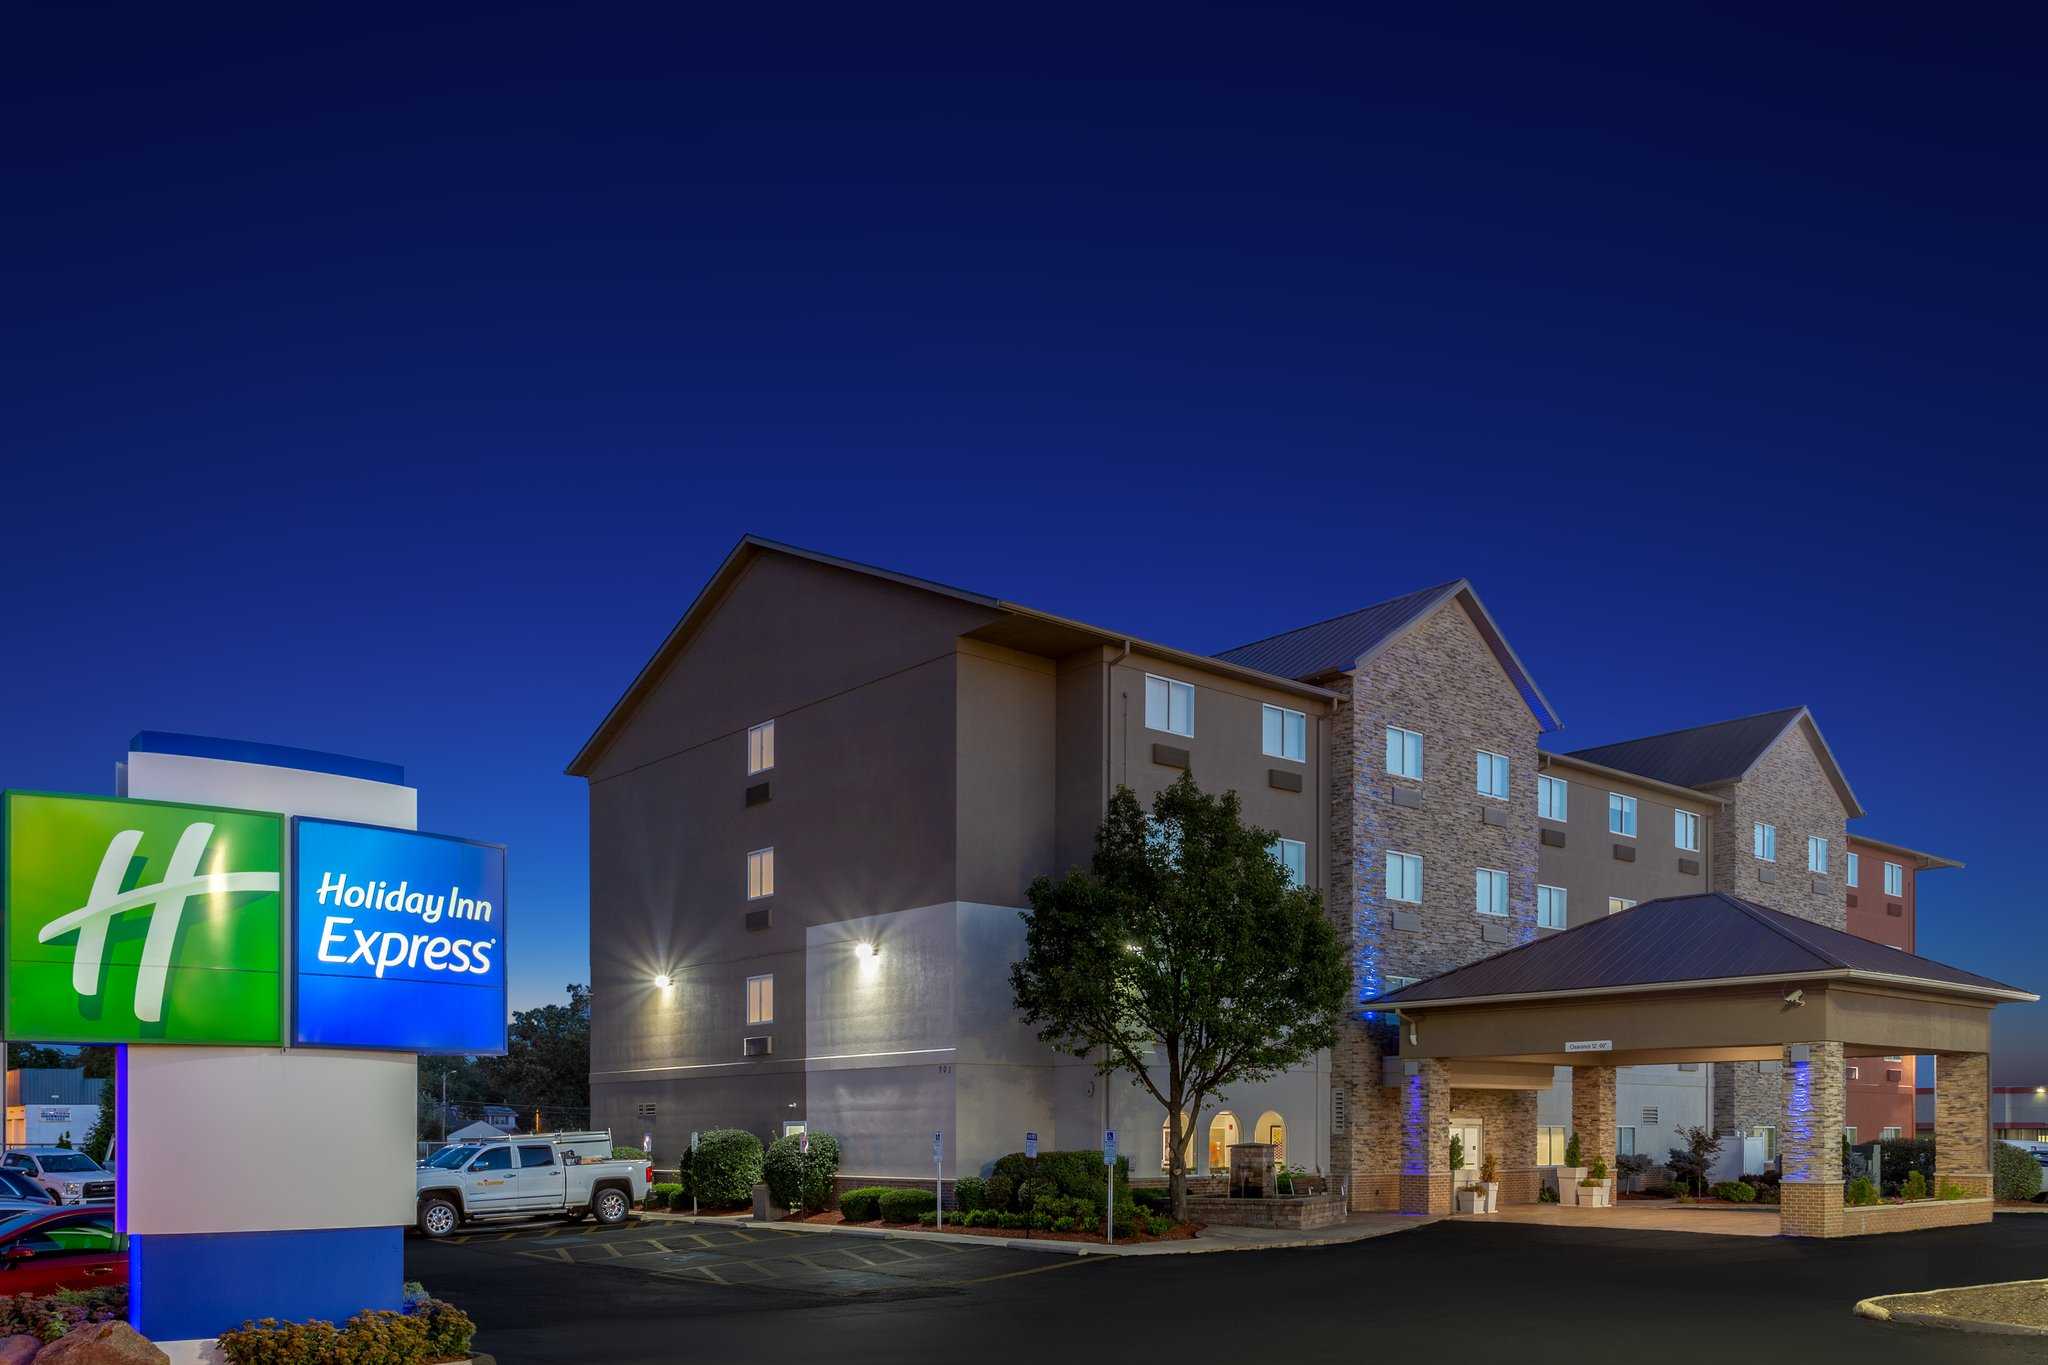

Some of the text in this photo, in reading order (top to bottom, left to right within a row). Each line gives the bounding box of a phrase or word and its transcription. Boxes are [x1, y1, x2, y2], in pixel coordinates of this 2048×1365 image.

[316, 871, 492, 923] Holiday Inn
[317, 915, 493, 979] Express
